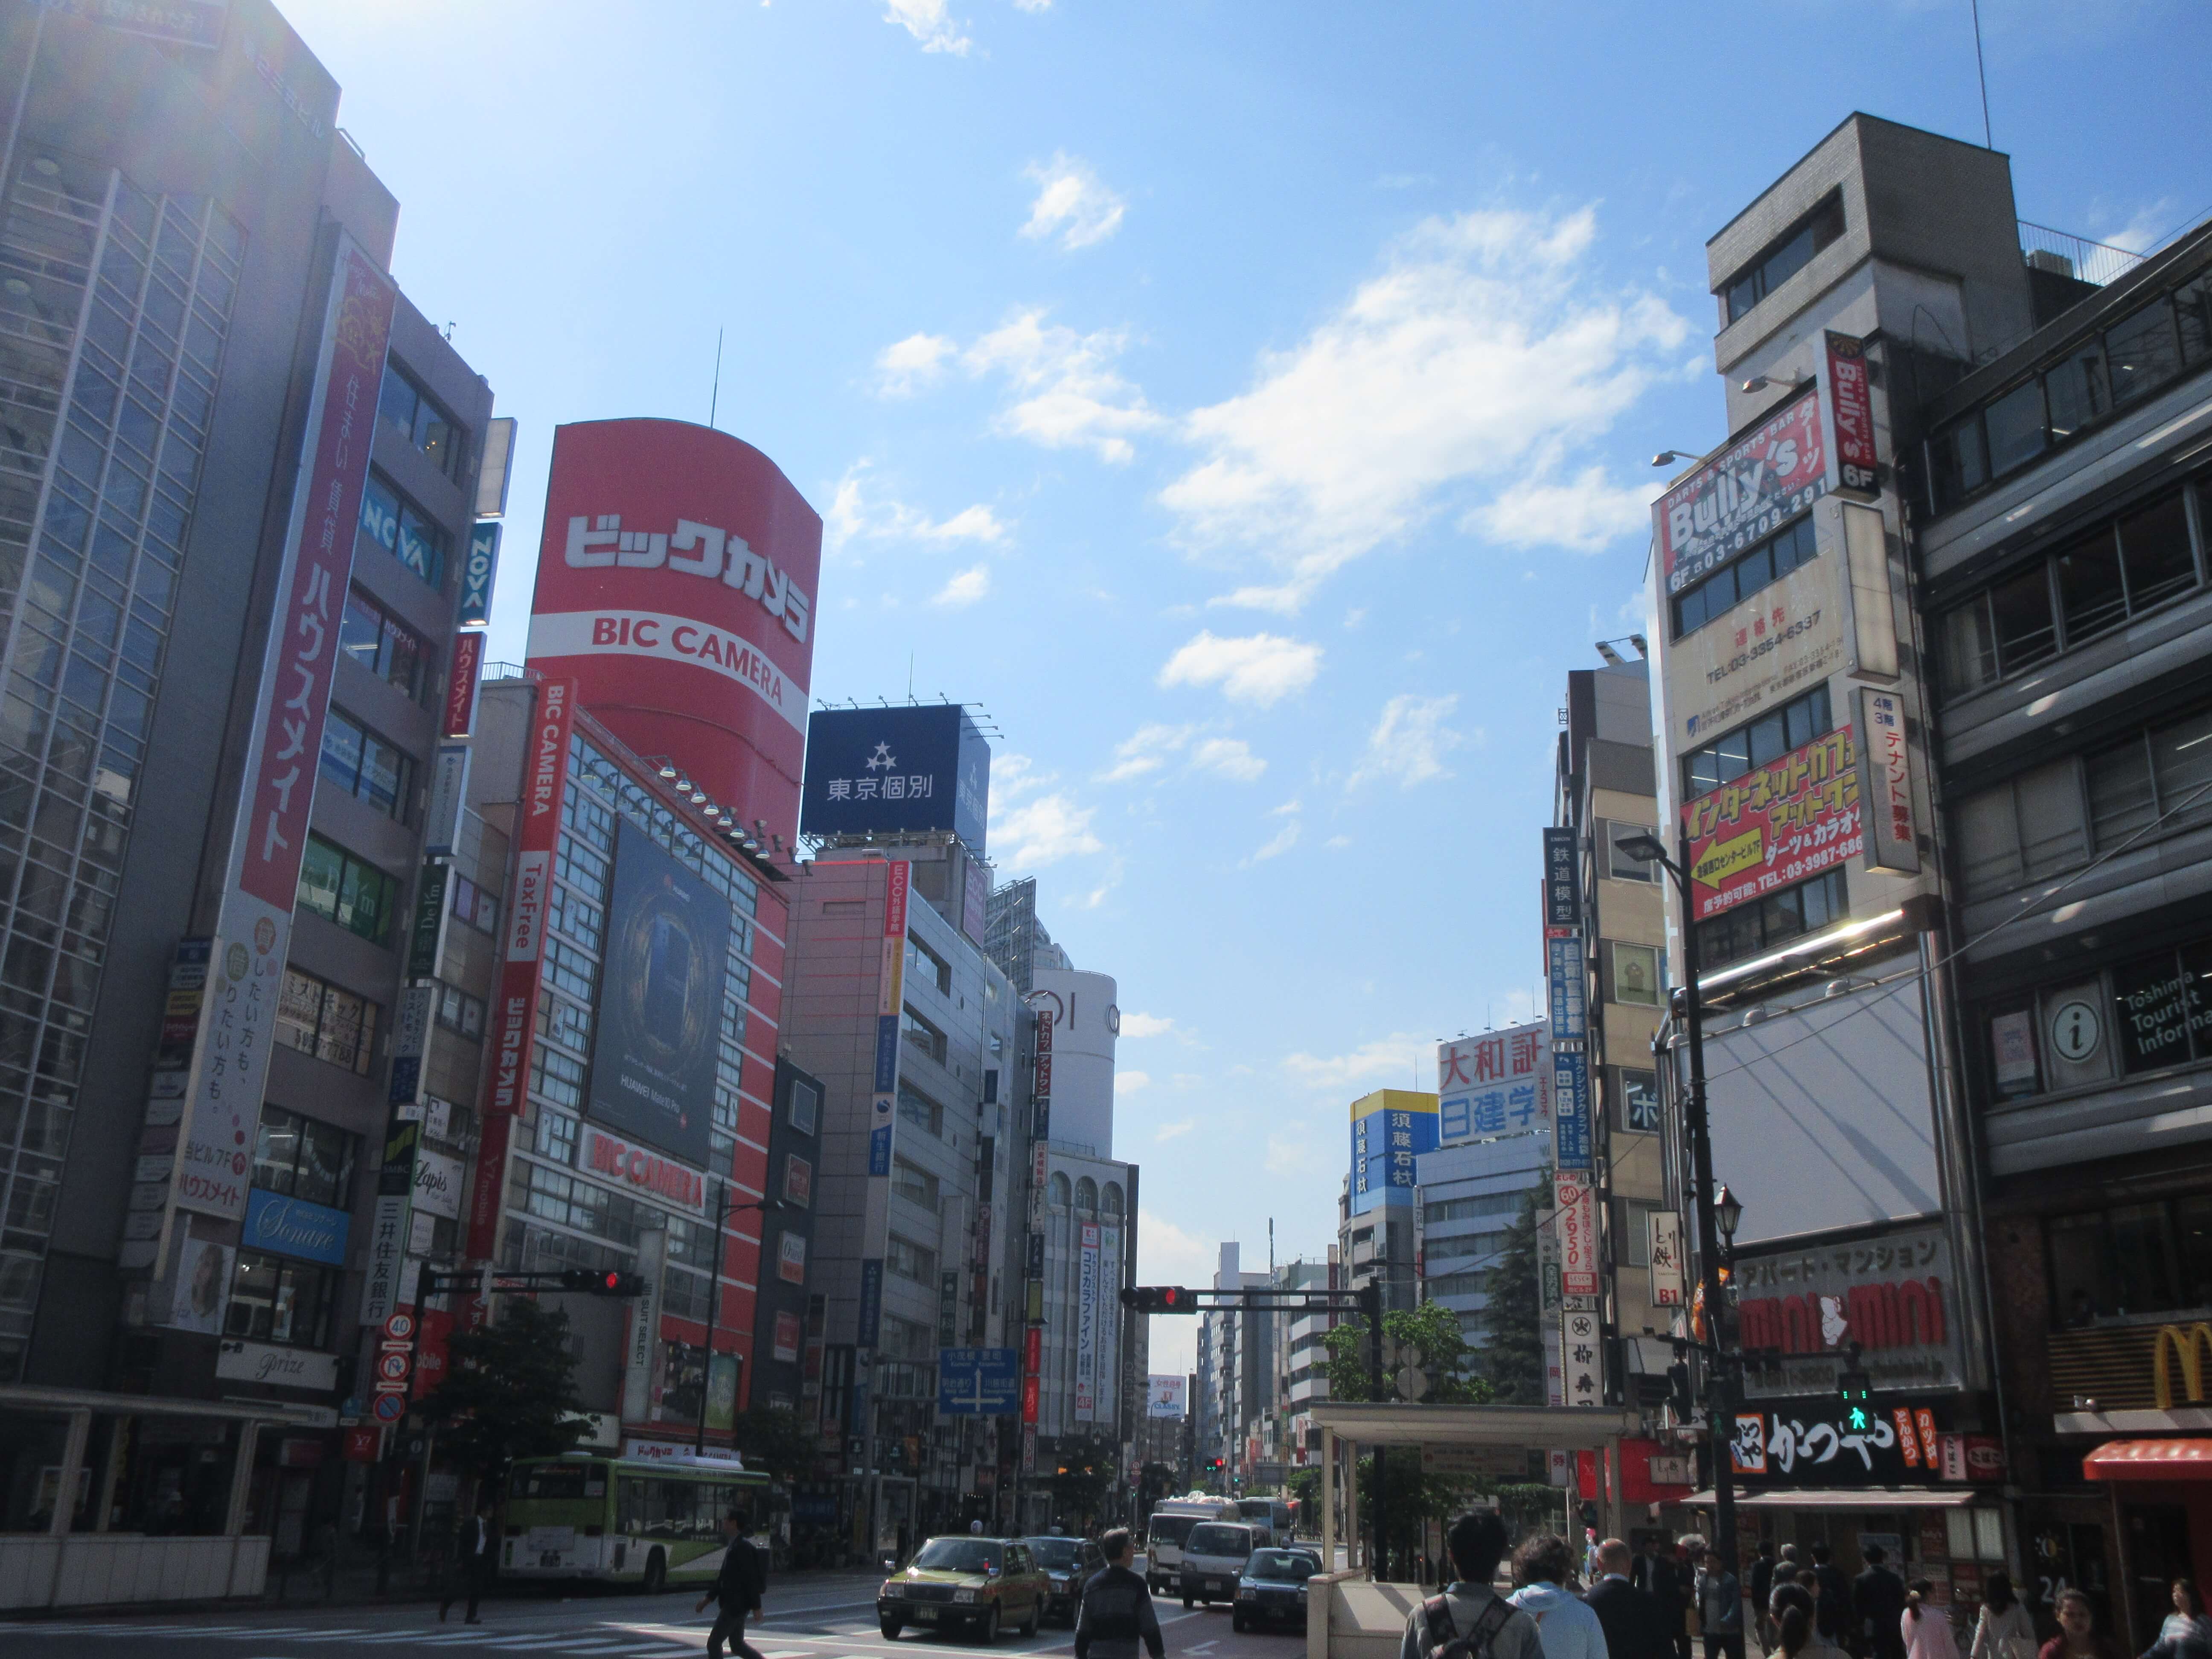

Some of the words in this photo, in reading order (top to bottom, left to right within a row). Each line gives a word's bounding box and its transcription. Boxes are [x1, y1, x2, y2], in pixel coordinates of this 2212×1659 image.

[1668, 479, 1703, 508] DARTS
[1719, 433, 1766, 469] SPORTS
[1771, 412, 1795, 437] BAR
[1799, 396, 1820, 474] ダーツ
[1670, 438, 1799, 551] Bully's
[1843, 464, 1874, 487] 6F
[364, 499, 425, 577] NOVA
[463, 537, 492, 608] NOVA
[565, 513, 809, 643] ビックカメラ
[1670, 564, 1690, 591] 6F
[451, 639, 474, 730] ハウスメイト
[592, 617, 661, 648] BIC
[671, 626, 783, 707] CAMERA
[263, 562, 331, 862] ハウスメイト
[545, 684, 564, 720] BIC
[1873, 697, 1893, 711] 4階
[1874, 712, 1895, 727] 3階
[533, 727, 559, 816] CAMERA
[827, 774, 934, 802] 東京個別
[1885, 732, 1912, 842] テナント募集
[515, 864, 542, 949] TaxFree
[1553, 847, 1572, 921] 鉄道模型
[2126, 971, 2195, 1011] Toshima
[2131, 990, 2202, 1033] Tourist
[1040, 1012, 1051, 1051] ネットカフェ
[1038, 1054, 1050, 1094] アットワン
[1440, 1028, 1544, 1091] 大和証
[620, 1074, 649, 1100] HUAWEI
[1441, 1084, 1535, 1139] 日建学
[384, 1164, 410, 1174] SMBC
[593, 1133, 627, 1176] BIC
[630, 1151, 702, 1208] CAMERA
[1357, 1119, 1366, 1193] 須藤石材
[1392, 1113, 1412, 1187] 須藤石材
[180, 1174, 240, 1206] ハウスメイト
[414, 1159, 448, 1195] Lapis
[368, 1202, 399, 1319] 三井住友銀行
[1566, 1207, 1579, 1266] 2950
[1741, 1239, 1937, 1289] アパート・マンション
[640, 1299, 649, 1323] SUIT
[1080, 1251, 1092, 1350] ココカラファイン
[1659, 1289, 1677, 1304] B1
[392, 1320, 408, 1333] 40
[636, 1326, 647, 1366] SELECT
[416, 1352, 441, 1370] obile
[1078, 1397, 1092, 1409] 4F
[1767, 1412, 1895, 1474] かつや
[1896, 1411, 1916, 1460] とんかつ
